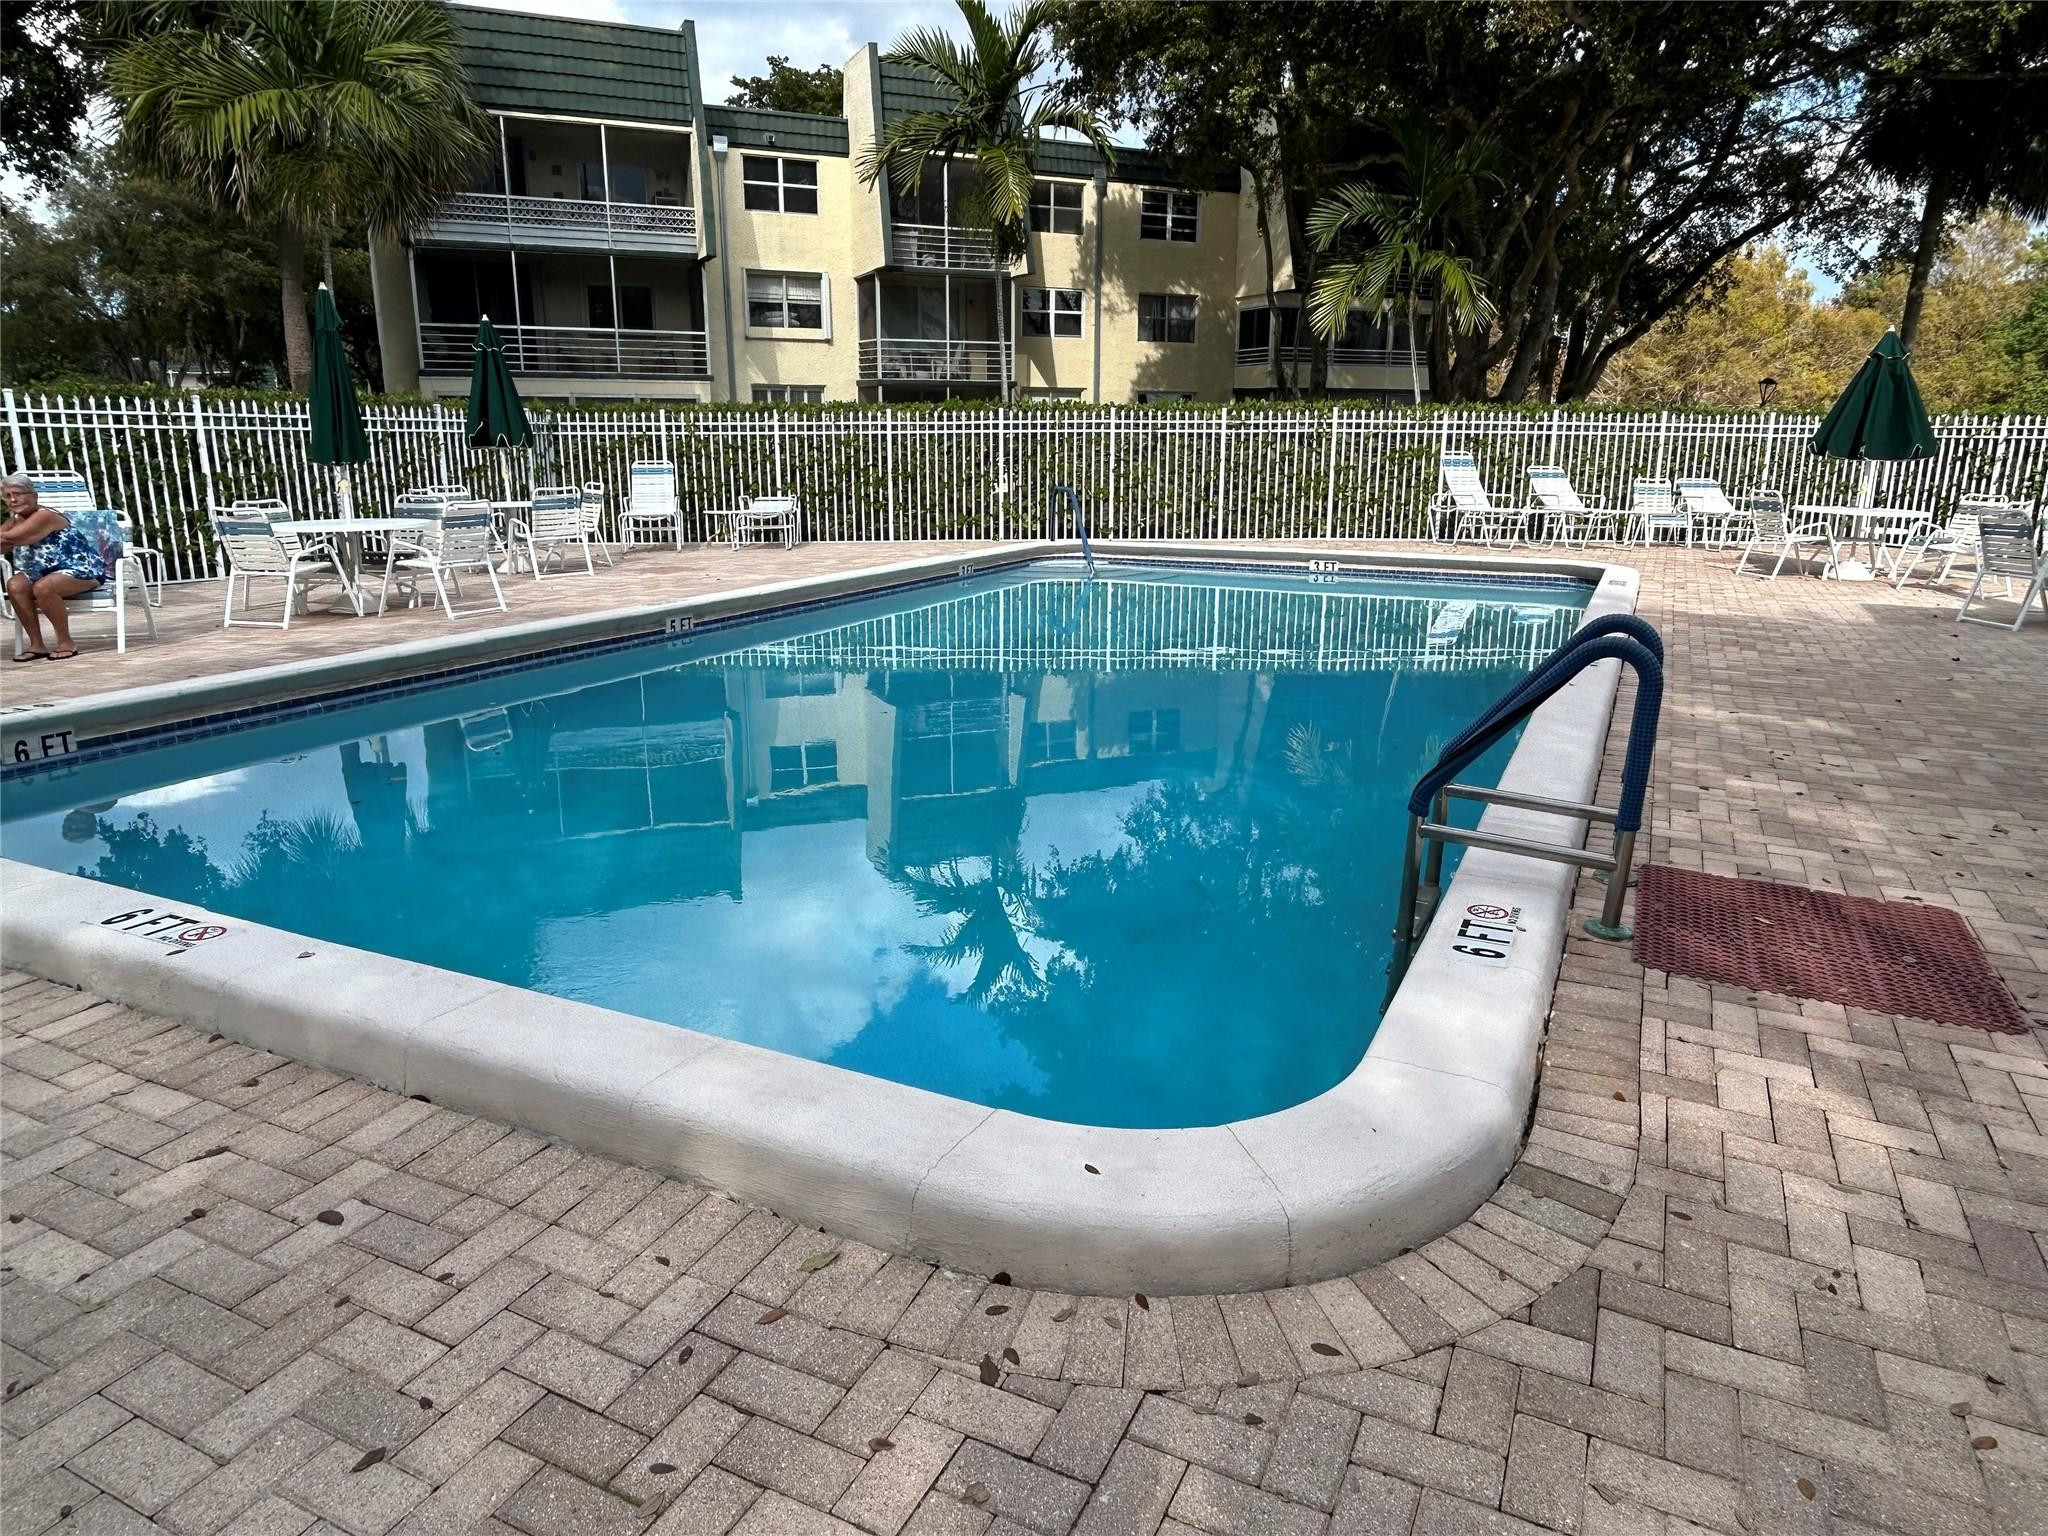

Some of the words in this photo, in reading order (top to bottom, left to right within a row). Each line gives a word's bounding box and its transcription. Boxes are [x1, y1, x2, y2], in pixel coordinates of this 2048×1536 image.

[1313, 561, 1320, 572] 3
[1323, 562, 1337, 572] FT
[680, 616, 693, 630] FT
[14, 739, 30, 763] 6
[40, 730, 73, 758] FT
[100, 908, 155, 925] 6
[121, 913, 202, 936] FT
[1457, 918, 1514, 945] FT
[1452, 944, 1506, 959] 6
